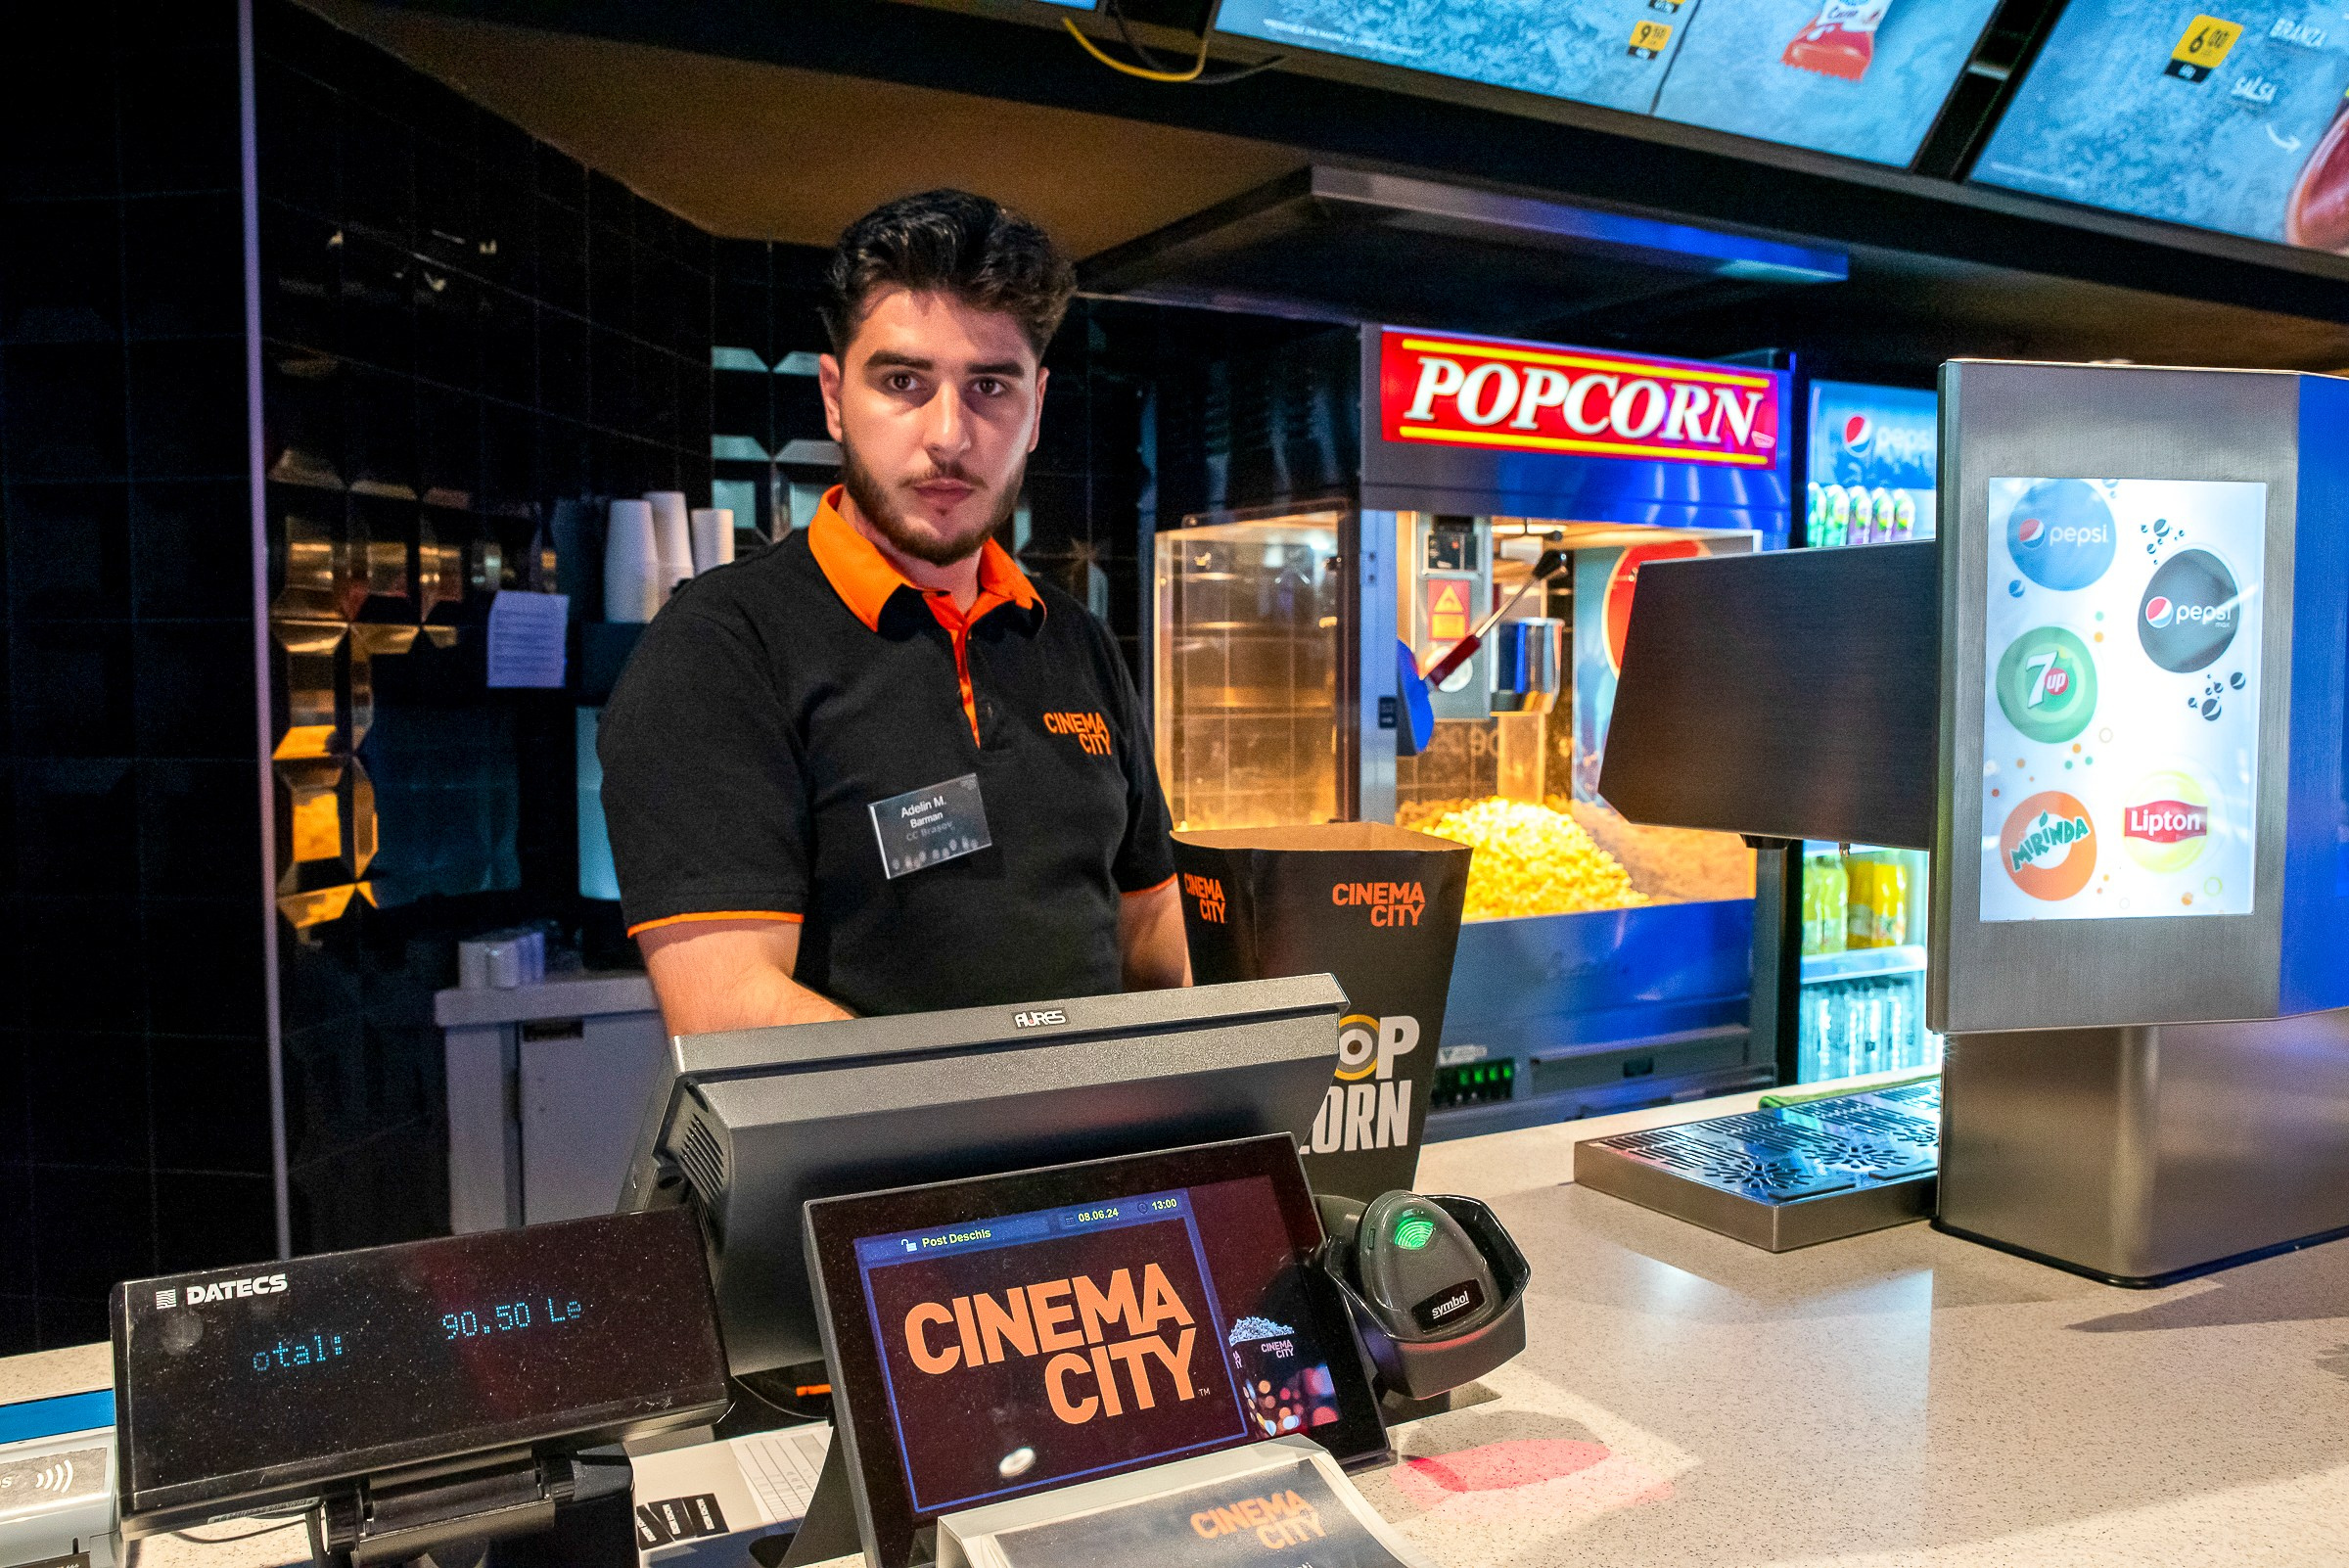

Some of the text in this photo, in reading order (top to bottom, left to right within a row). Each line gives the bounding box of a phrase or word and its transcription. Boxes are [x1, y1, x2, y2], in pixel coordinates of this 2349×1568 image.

[1404, 356, 1764, 447] POPCORN
[2050, 524, 2107, 547] pepsi
[2175, 604, 2232, 625] pepsi
[1043, 712, 1110, 734] CINEMA
[1079, 732, 1112, 756] CITY
[901, 795, 947, 818] Adelin M.
[910, 811, 944, 829] Barman
[2131, 810, 2200, 836] Lipton
[2011, 816, 2089, 871] MIRINDA
[1184, 872, 1225, 902] CINEMA
[1332, 881, 1426, 906] CINEMA
[1199, 898, 1226, 924] CITY
[1370, 903, 1426, 928] CITY
[1015, 1009, 1067, 1028] AURES
[1299, 1080, 1412, 1155] ORN
[921, 1235, 948, 1248] Post
[1078, 1208, 1120, 1222] 08.06.24
[1152, 1198, 1177, 1211] 13:00
[187, 1273, 289, 1306] DATECS
[1432, 1290, 1470, 1317] symbol
[442, 1301, 531, 1341] 90.50
[904, 1263, 1195, 1375] CINEMA
[1261, 1339, 1294, 1353] CINEMA
[1275, 1347, 1294, 1359] CITY
[1043, 1327, 1197, 1425] CITY
[1190, 1489, 1314, 1540] CINEMA
[1256, 1511, 1327, 1549] CITY
